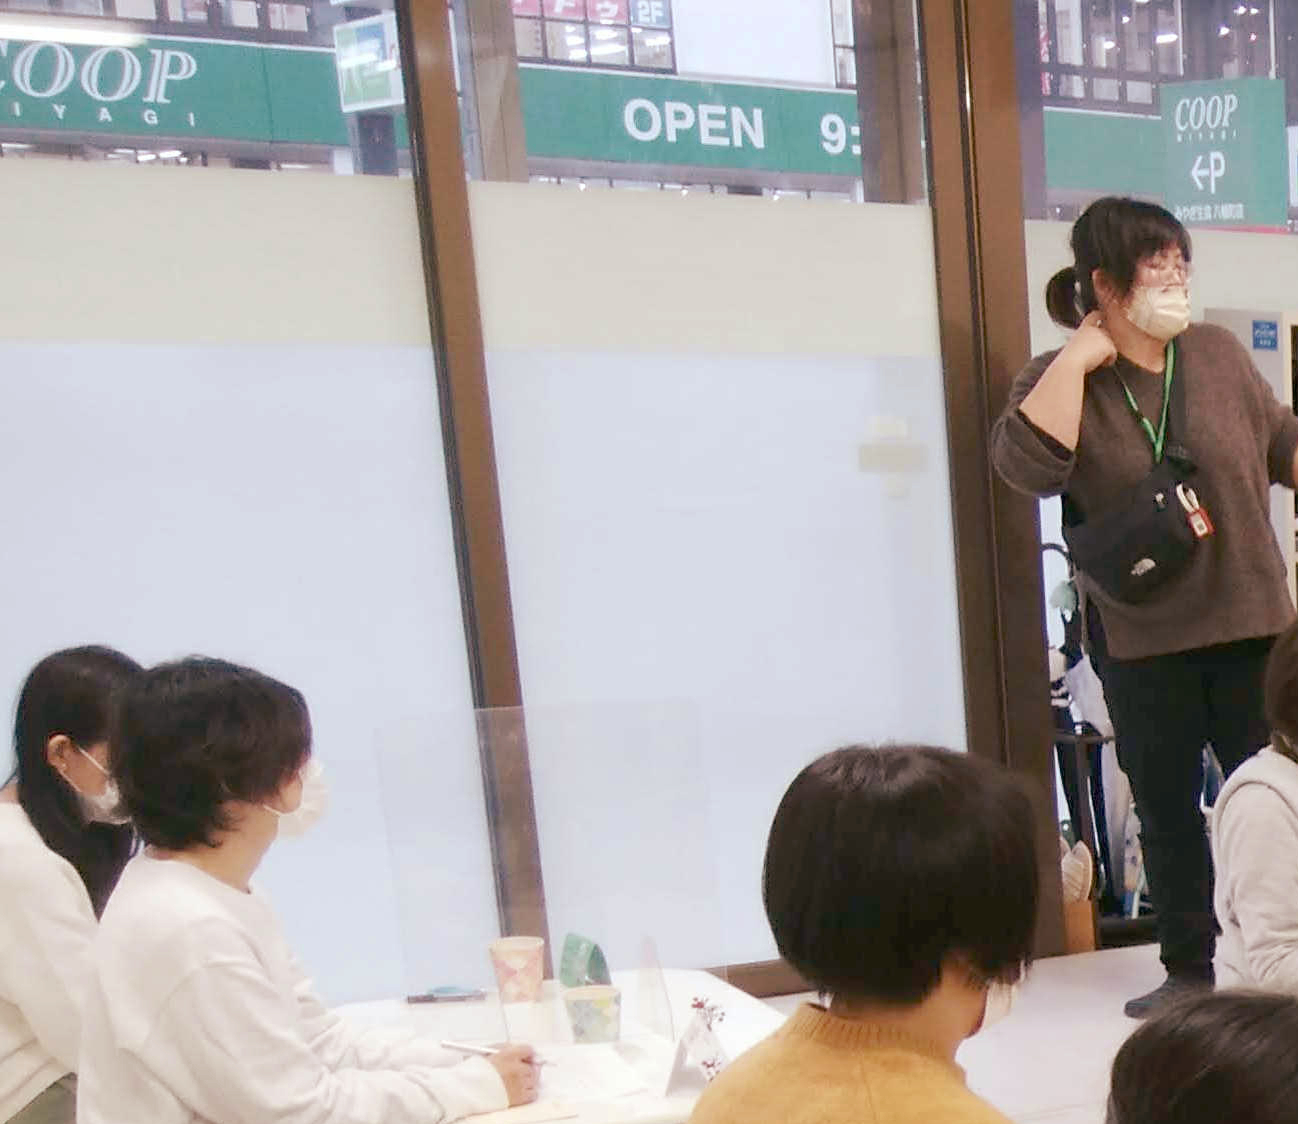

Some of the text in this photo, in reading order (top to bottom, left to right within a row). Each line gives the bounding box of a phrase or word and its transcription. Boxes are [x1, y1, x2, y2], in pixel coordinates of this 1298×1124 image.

[0, 39, 197, 104] OOP
[624, 98, 765, 149] OPEN
[1175, 94, 1238, 131] COOP
[1210, 152, 1226, 194] P
